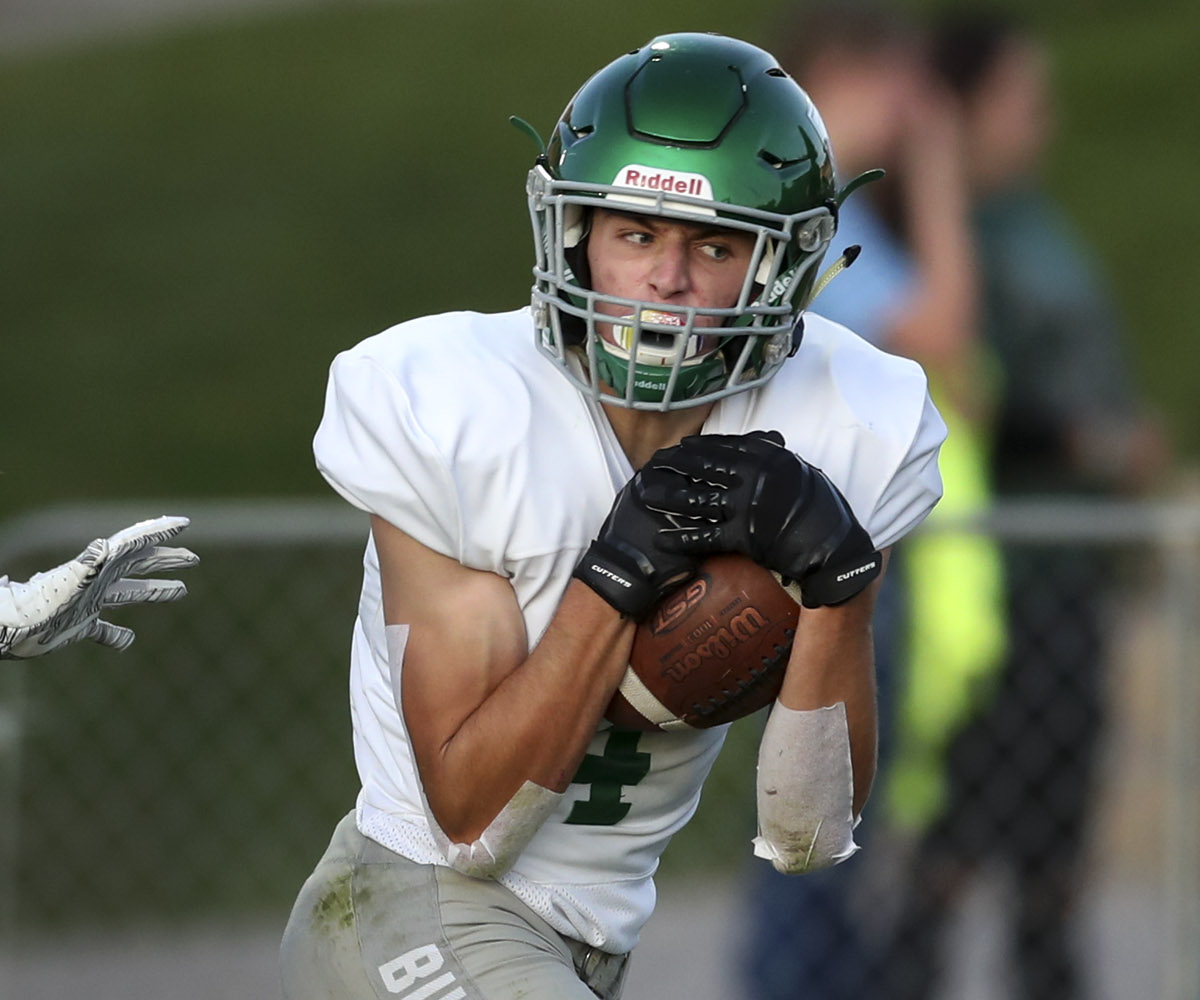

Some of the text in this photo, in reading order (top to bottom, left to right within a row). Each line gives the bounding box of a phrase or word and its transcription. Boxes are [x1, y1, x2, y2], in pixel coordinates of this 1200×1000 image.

[625, 169, 703, 195] Riddell
[591, 564, 632, 588] CUTTERS
[836, 561, 876, 582] CUTTERS
[661, 606, 770, 681] Wilson
